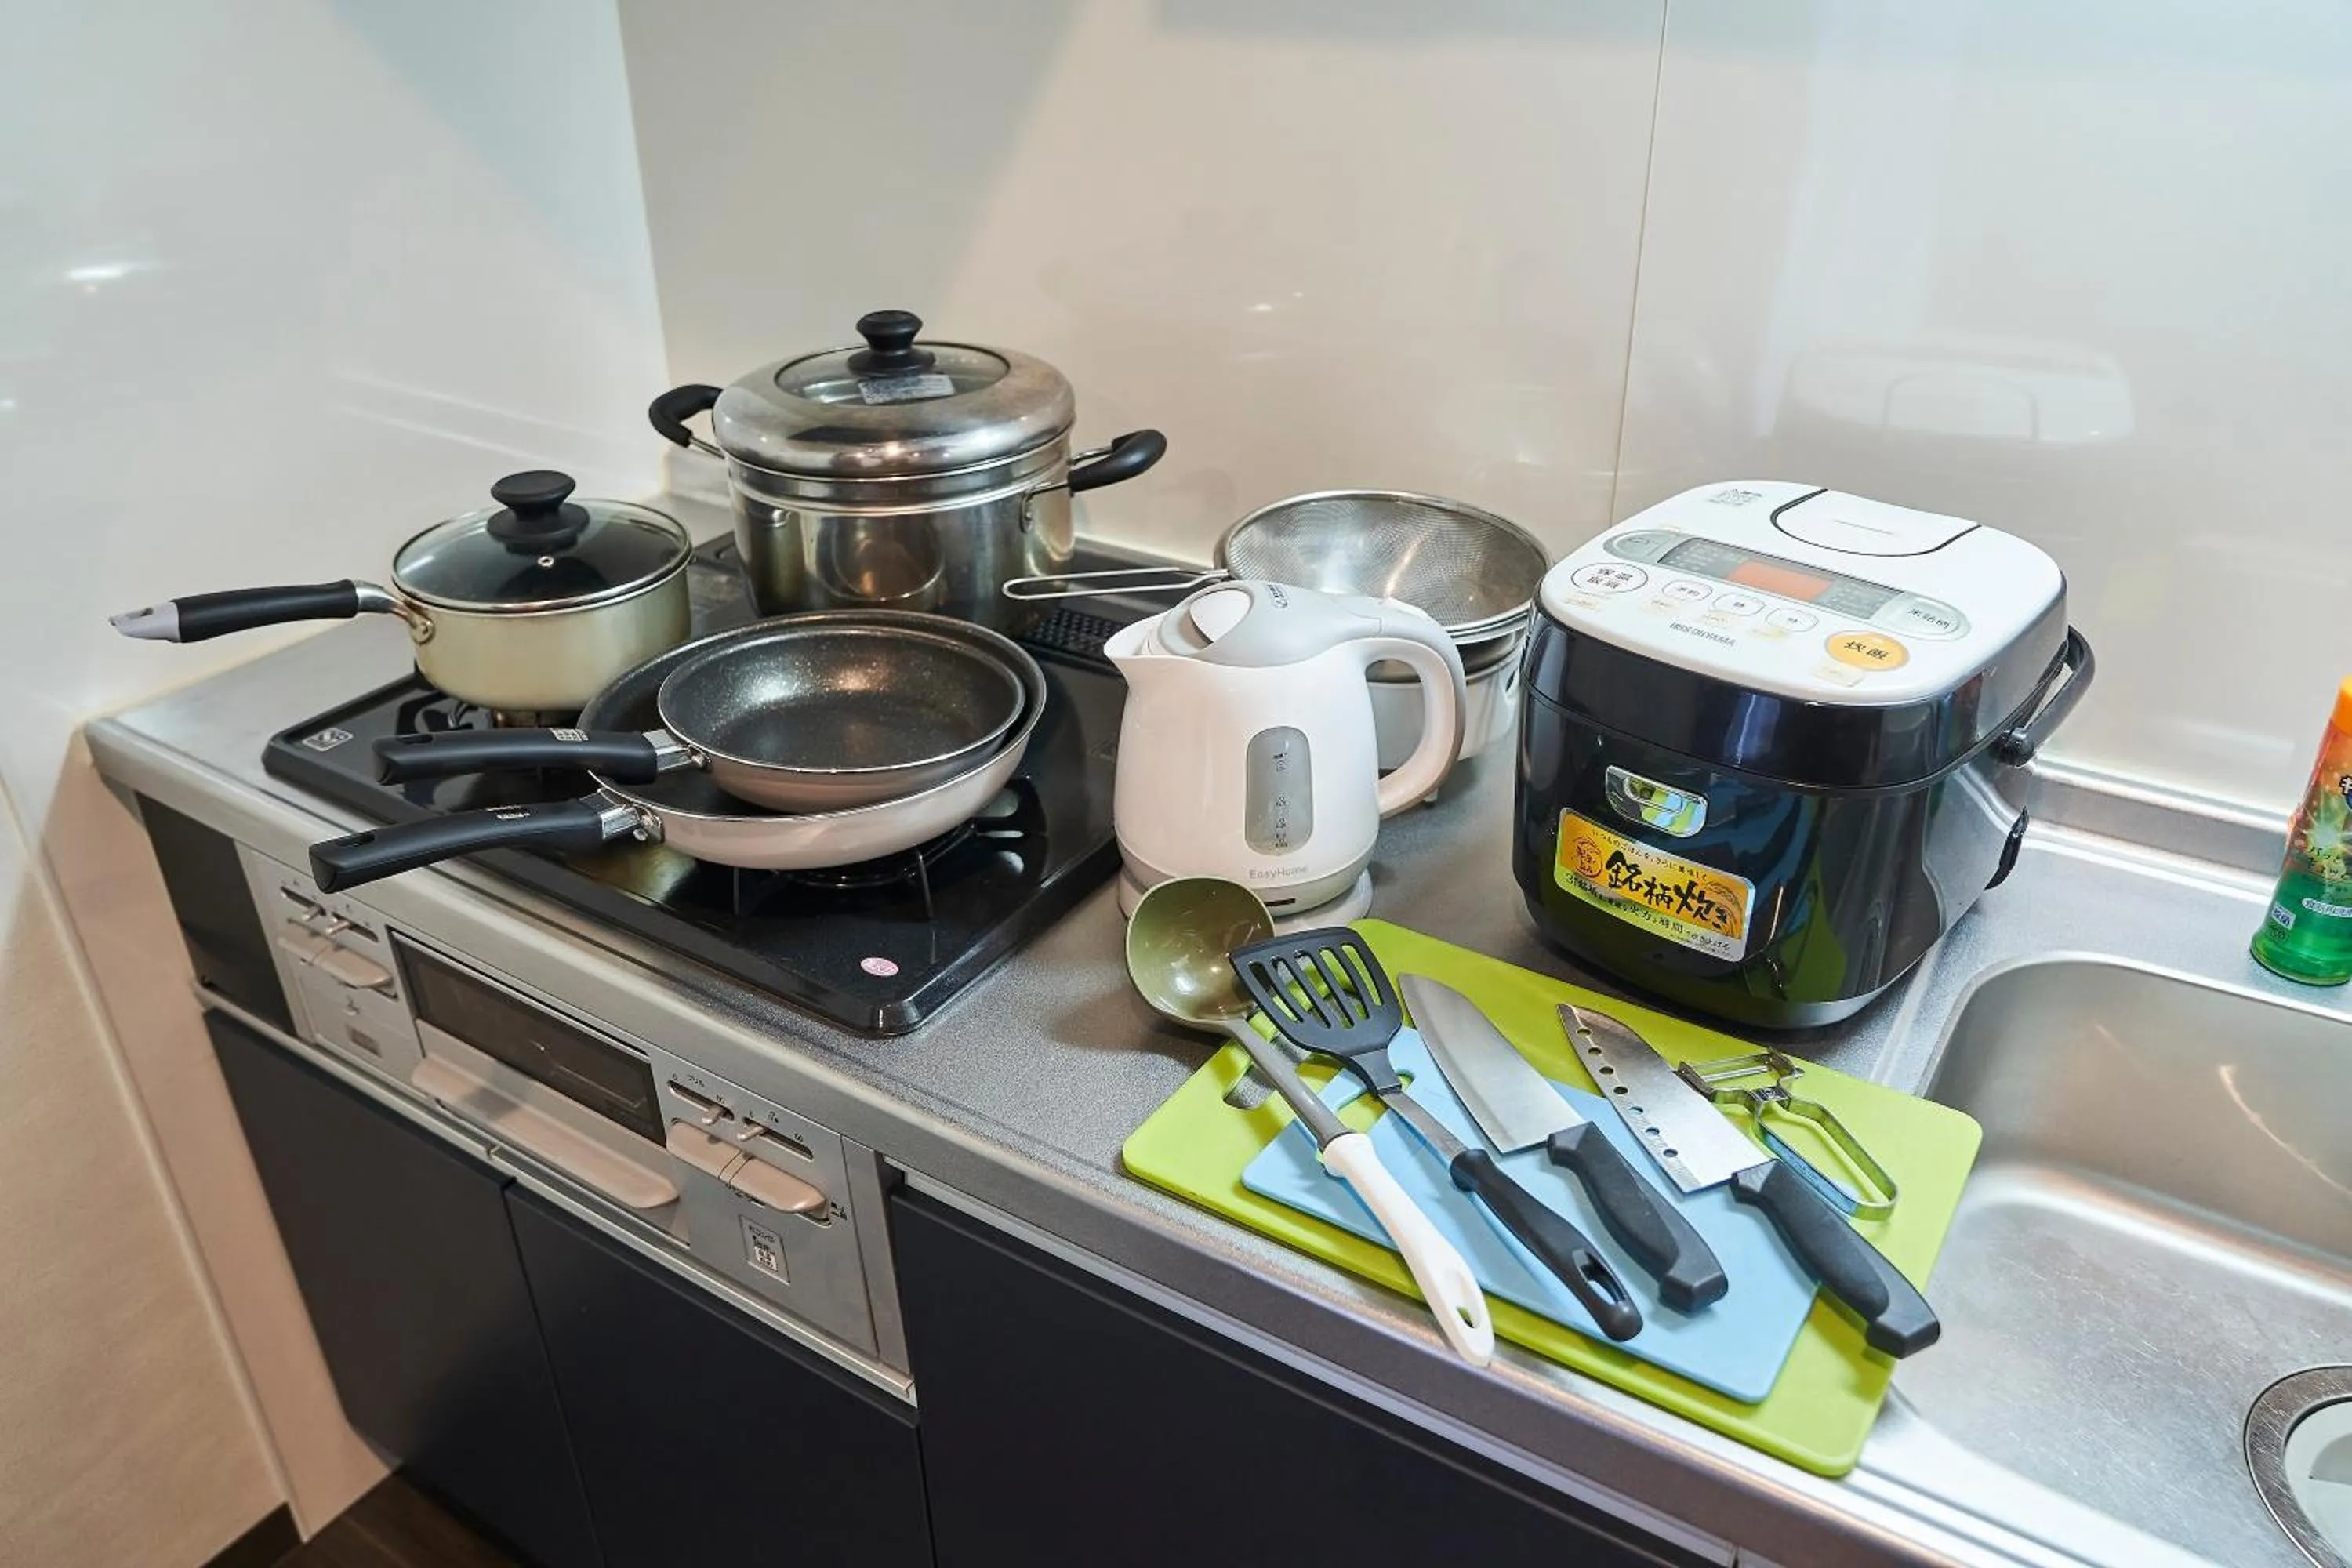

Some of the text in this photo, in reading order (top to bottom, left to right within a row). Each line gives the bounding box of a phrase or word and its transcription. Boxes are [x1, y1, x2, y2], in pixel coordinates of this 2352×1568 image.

[1844, 640, 1889, 661] 炊飯
[1605, 849, 1729, 929] 銘柄炊き
